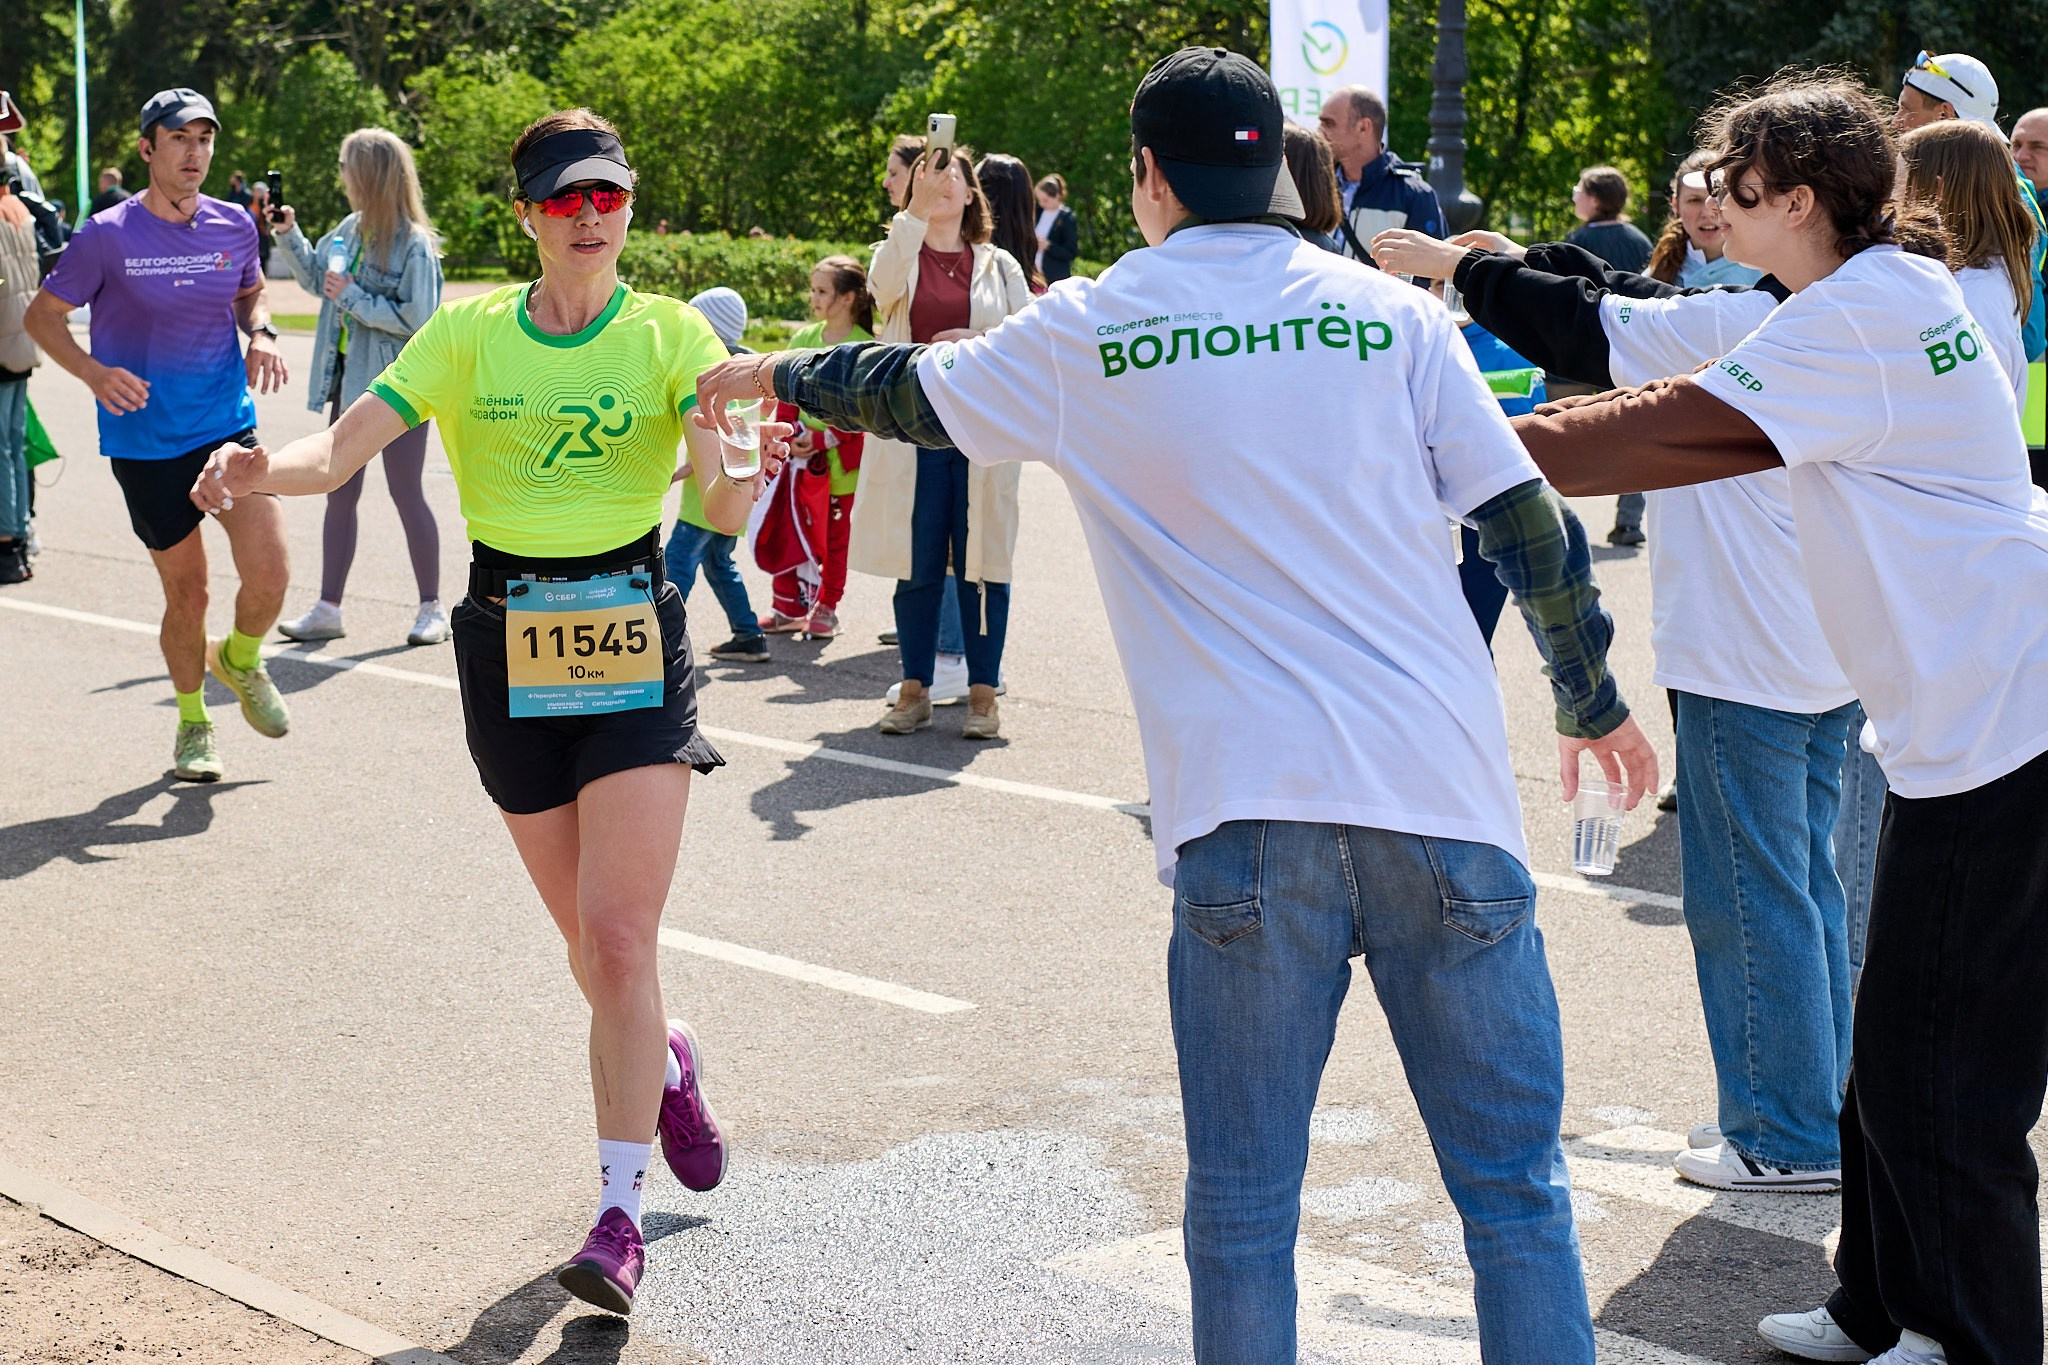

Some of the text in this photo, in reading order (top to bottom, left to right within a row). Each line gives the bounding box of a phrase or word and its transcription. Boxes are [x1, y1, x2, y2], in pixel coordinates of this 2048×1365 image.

[125, 253, 213, 267] БЕЛГОРОДСКИЙ
[1096, 311, 1224, 336] Сберегаем вместе
[1719, 360, 1763, 392] СБЕР
[555, 593, 577, 601] СБЕР
[522, 618, 648, 659] 11545
[567, 665, 586, 679] 10
